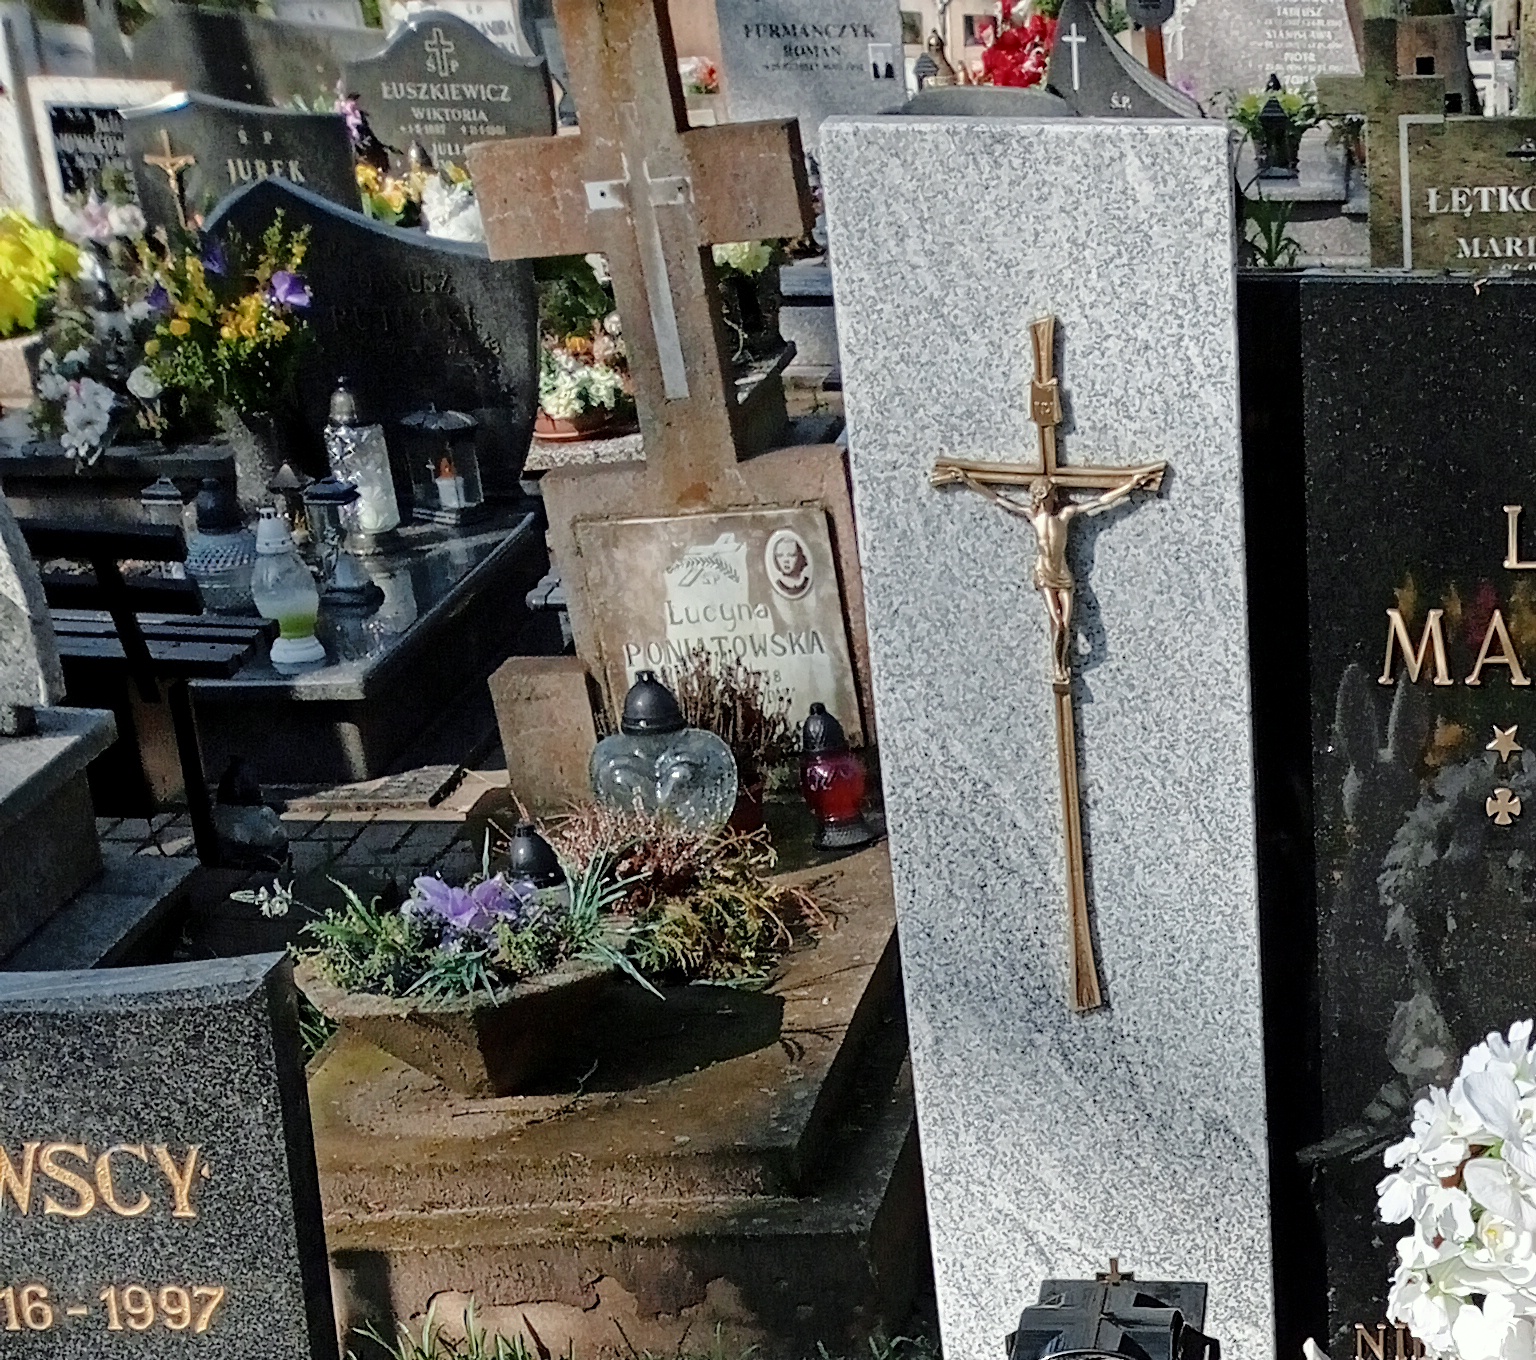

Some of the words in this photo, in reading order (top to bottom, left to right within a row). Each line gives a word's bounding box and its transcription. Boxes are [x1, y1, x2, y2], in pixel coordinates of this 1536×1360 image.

[411, 106, 489, 122] WIKTORIA
[666, 600, 770, 632] Lucyna
[100, 1284, 225, 1334] 1997
